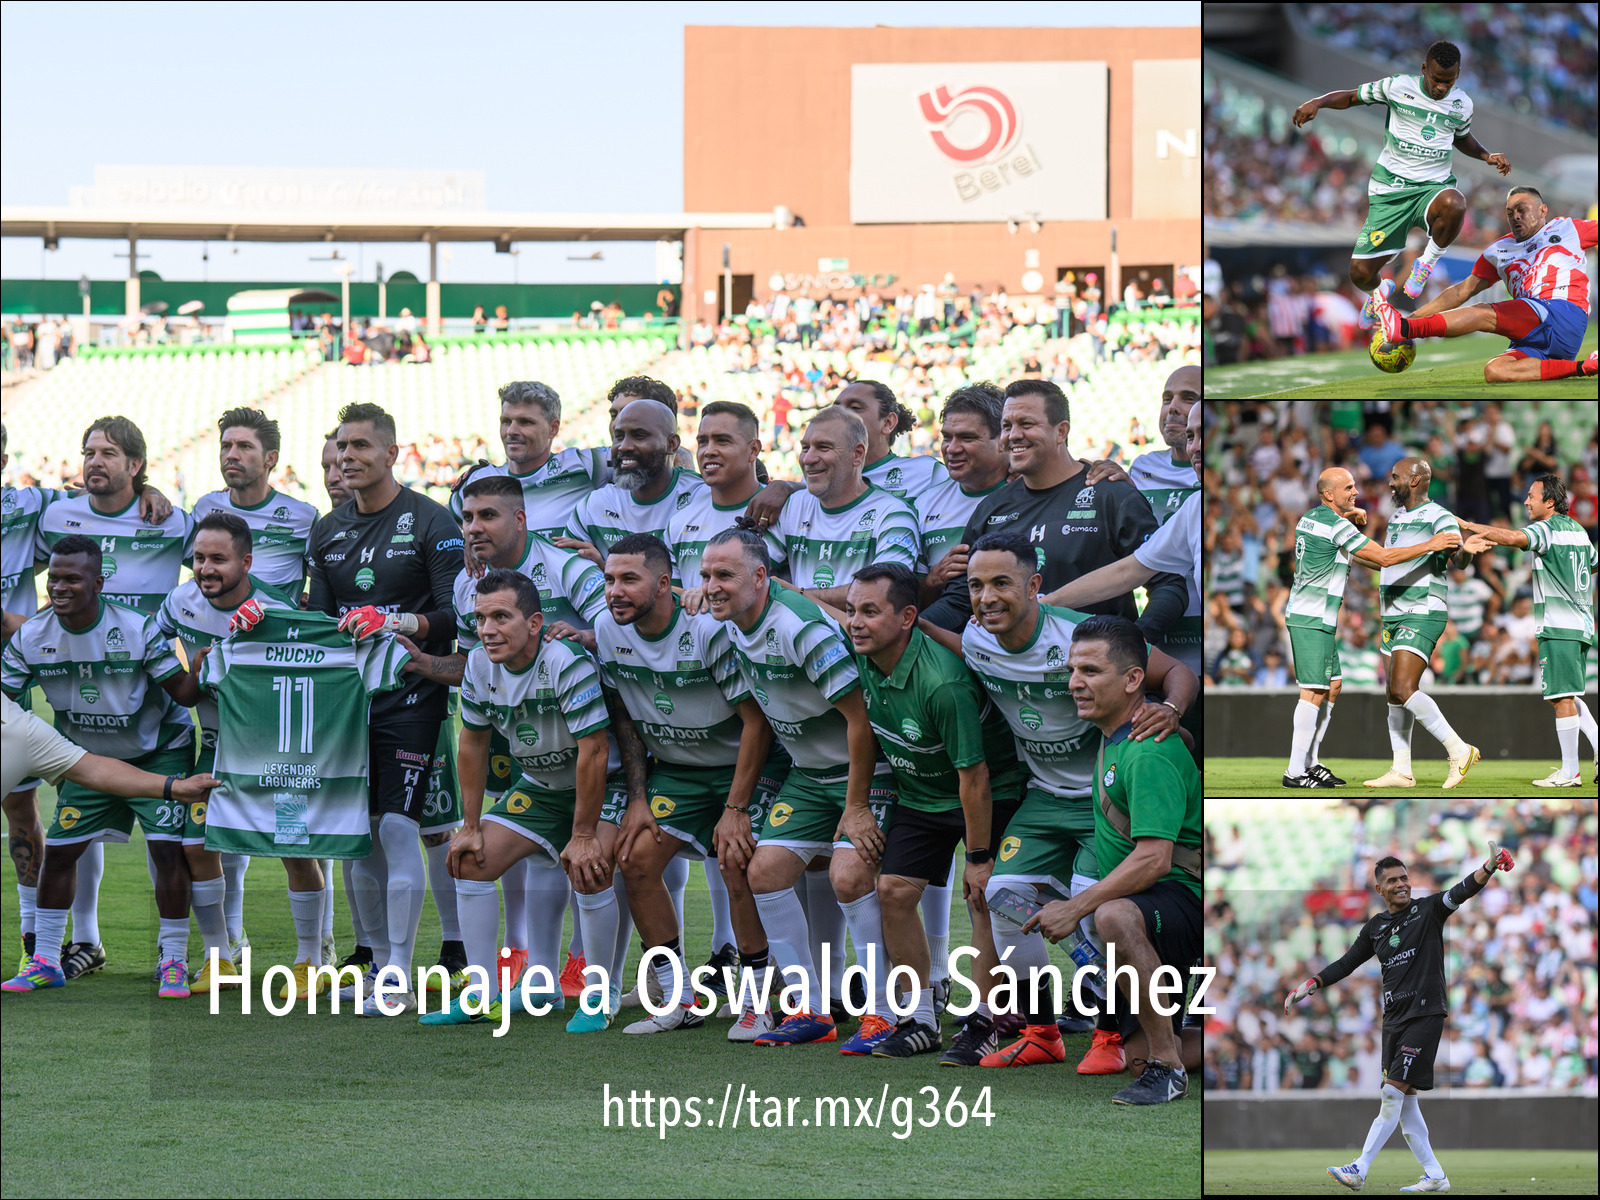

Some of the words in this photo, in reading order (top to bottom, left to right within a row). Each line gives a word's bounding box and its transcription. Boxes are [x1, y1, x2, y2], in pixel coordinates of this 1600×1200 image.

[953, 143, 1043, 204] Berel
[1569, 551, 1590, 593] 16
[265, 646, 326, 664] CHUCHO
[39, 668, 68, 676] SIMSA
[272, 675, 315, 754] 11
[263, 762, 317, 776] LEYENDAS
[258, 775, 322, 789] LAGUNERAS
[422, 789, 453, 817] 30
[156, 805, 185, 828] 28
